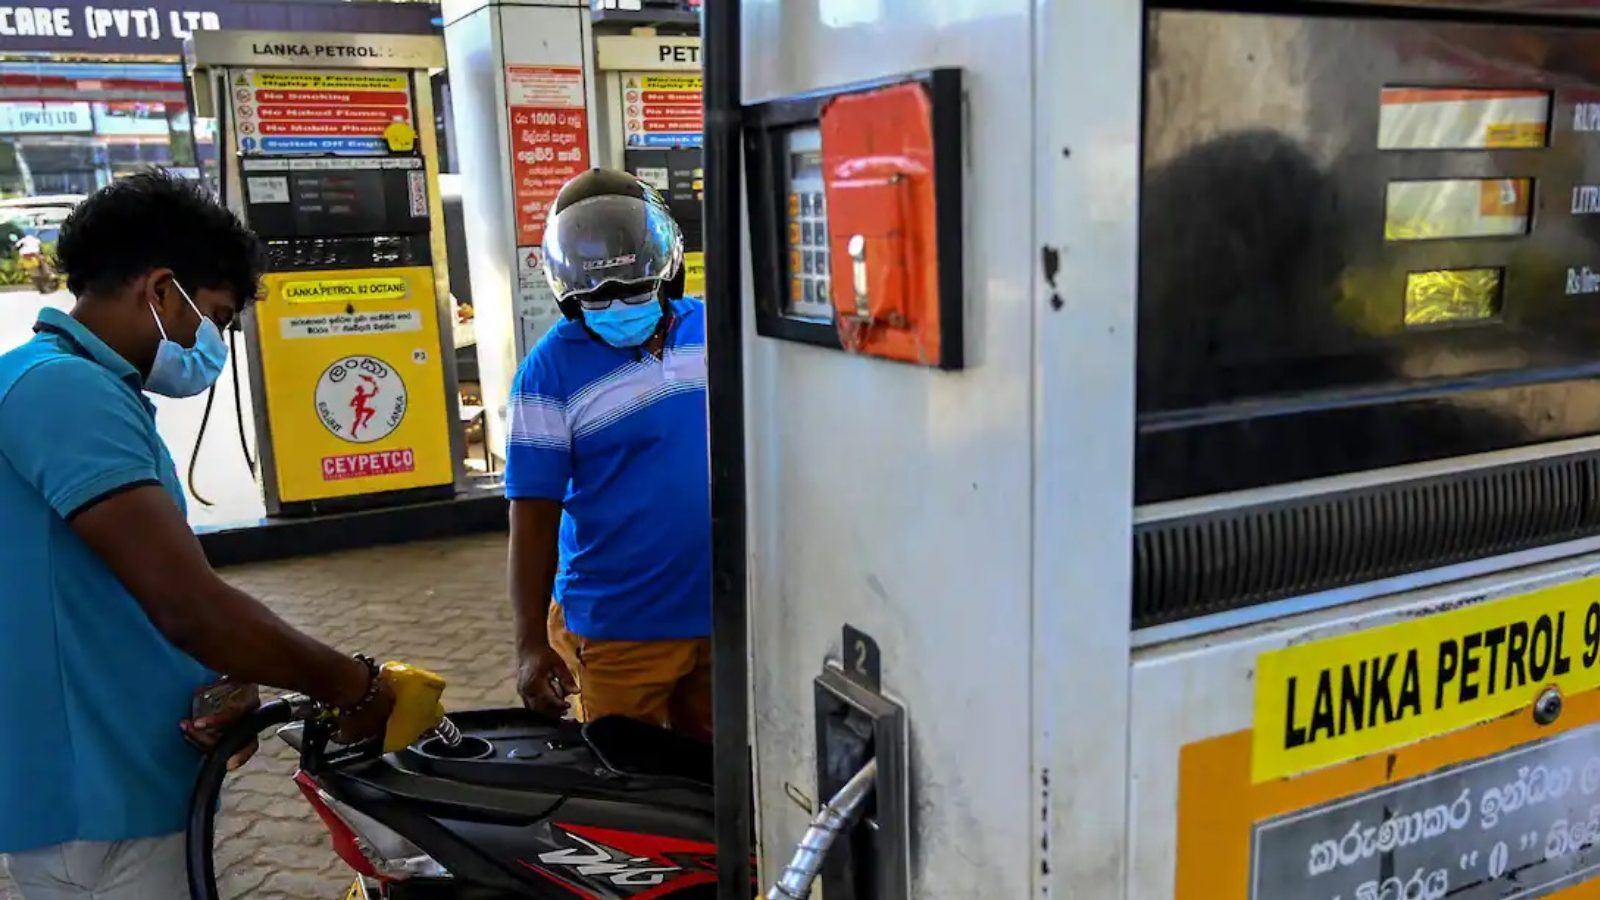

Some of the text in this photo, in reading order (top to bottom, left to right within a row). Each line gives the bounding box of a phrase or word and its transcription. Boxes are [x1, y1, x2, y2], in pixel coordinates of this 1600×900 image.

[0, 7, 73, 36] CARE
[85, 6, 160, 39] (PVT)
[252, 44, 310, 56] LANKA
[659, 45, 699, 62] PET
[288, 93, 350, 102] Smoking
[530, 112, 556, 125] 1000
[286, 287, 318, 298] LANKA
[320, 285, 355, 296] PETROL
[386, 395, 404, 428] LANKA
[323, 450, 413, 475] CEYPETCO
[854, 639, 867, 674] 2
[1284, 601, 1600, 750] LANKA PETROL 9
